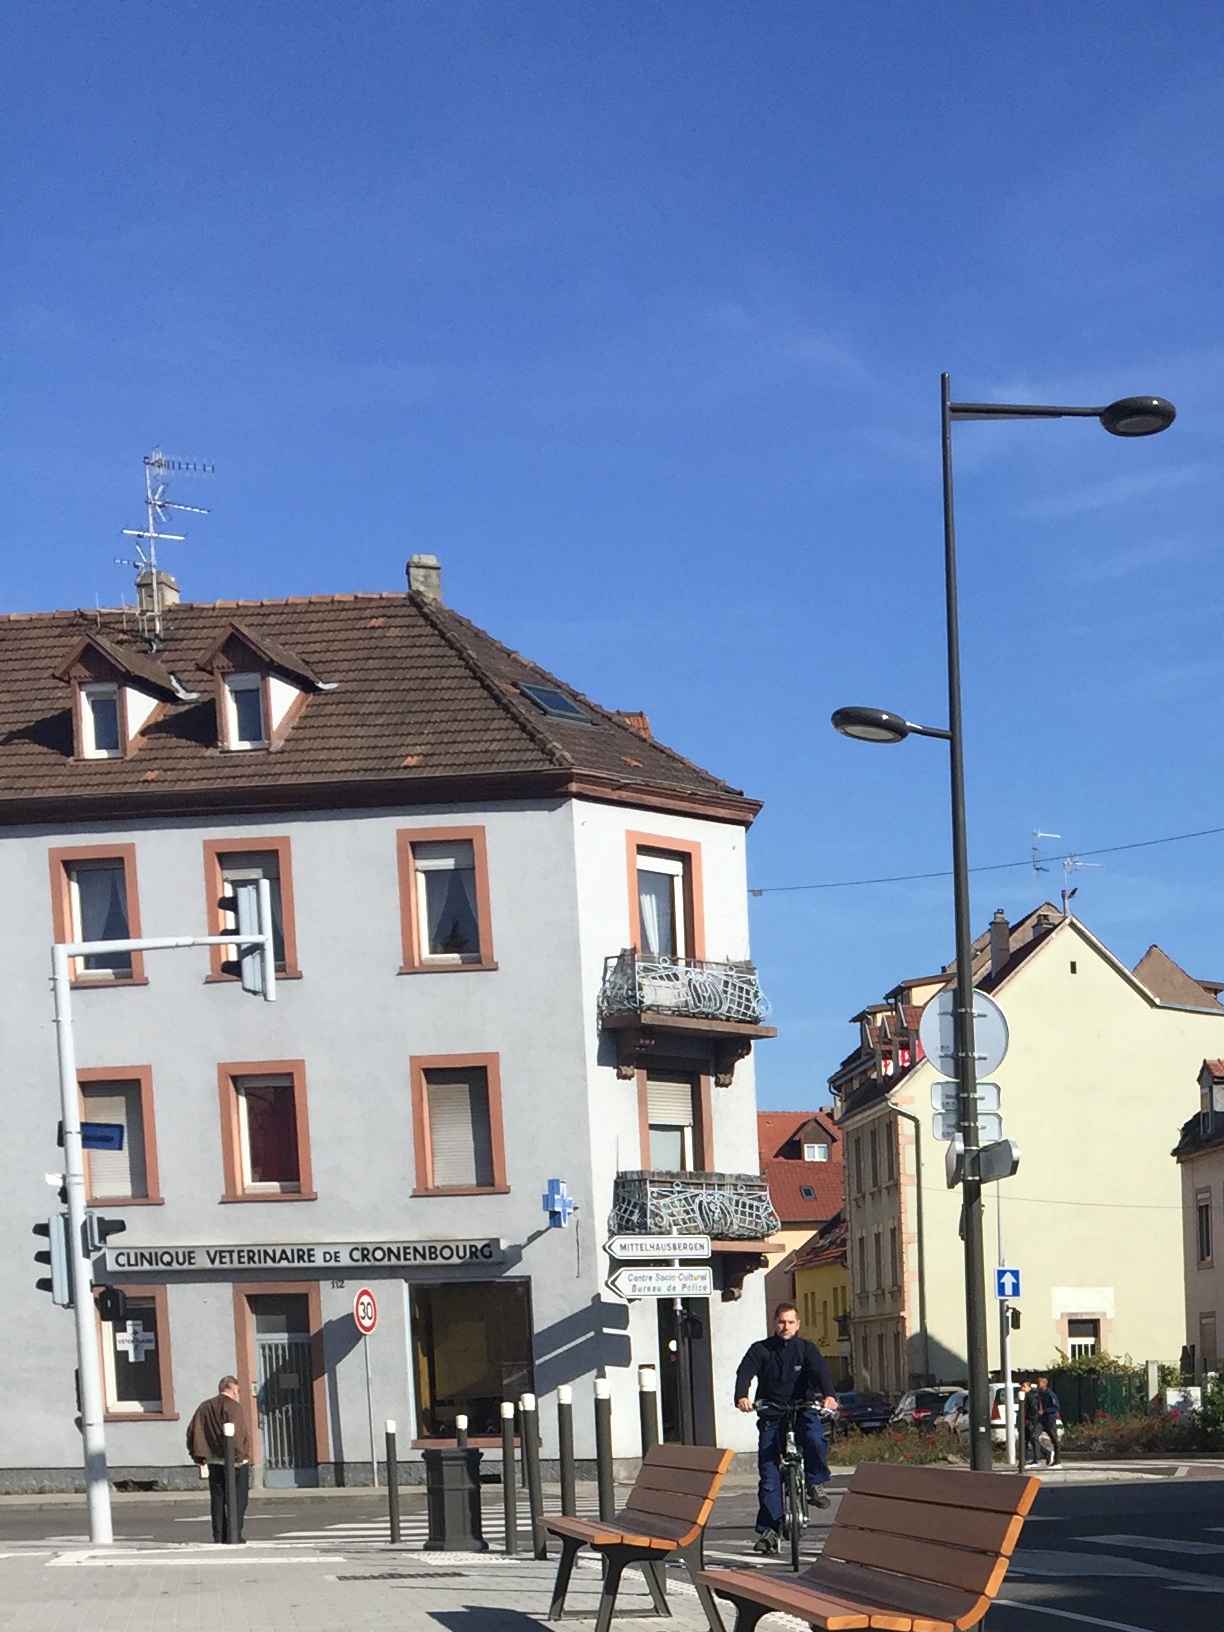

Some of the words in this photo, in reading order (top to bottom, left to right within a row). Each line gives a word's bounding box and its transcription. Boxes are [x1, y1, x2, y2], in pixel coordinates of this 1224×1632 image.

[619, 1242, 705, 1251] MITTELHAUSBERGEN
[115, 1251, 196, 1267] CLINIQUE
[206, 1248, 316, 1266] VETERINAIRE
[323, 1251, 341, 1263] DE
[349, 1243, 493, 1262] CRONENBOURG
[628, 1273, 652, 1282] Centre
[631, 1284, 661, 1292] Bureau
[667, 1284, 676, 1292] de
[681, 1283, 708, 1292] Police
[360, 1301, 373, 1320] 30
